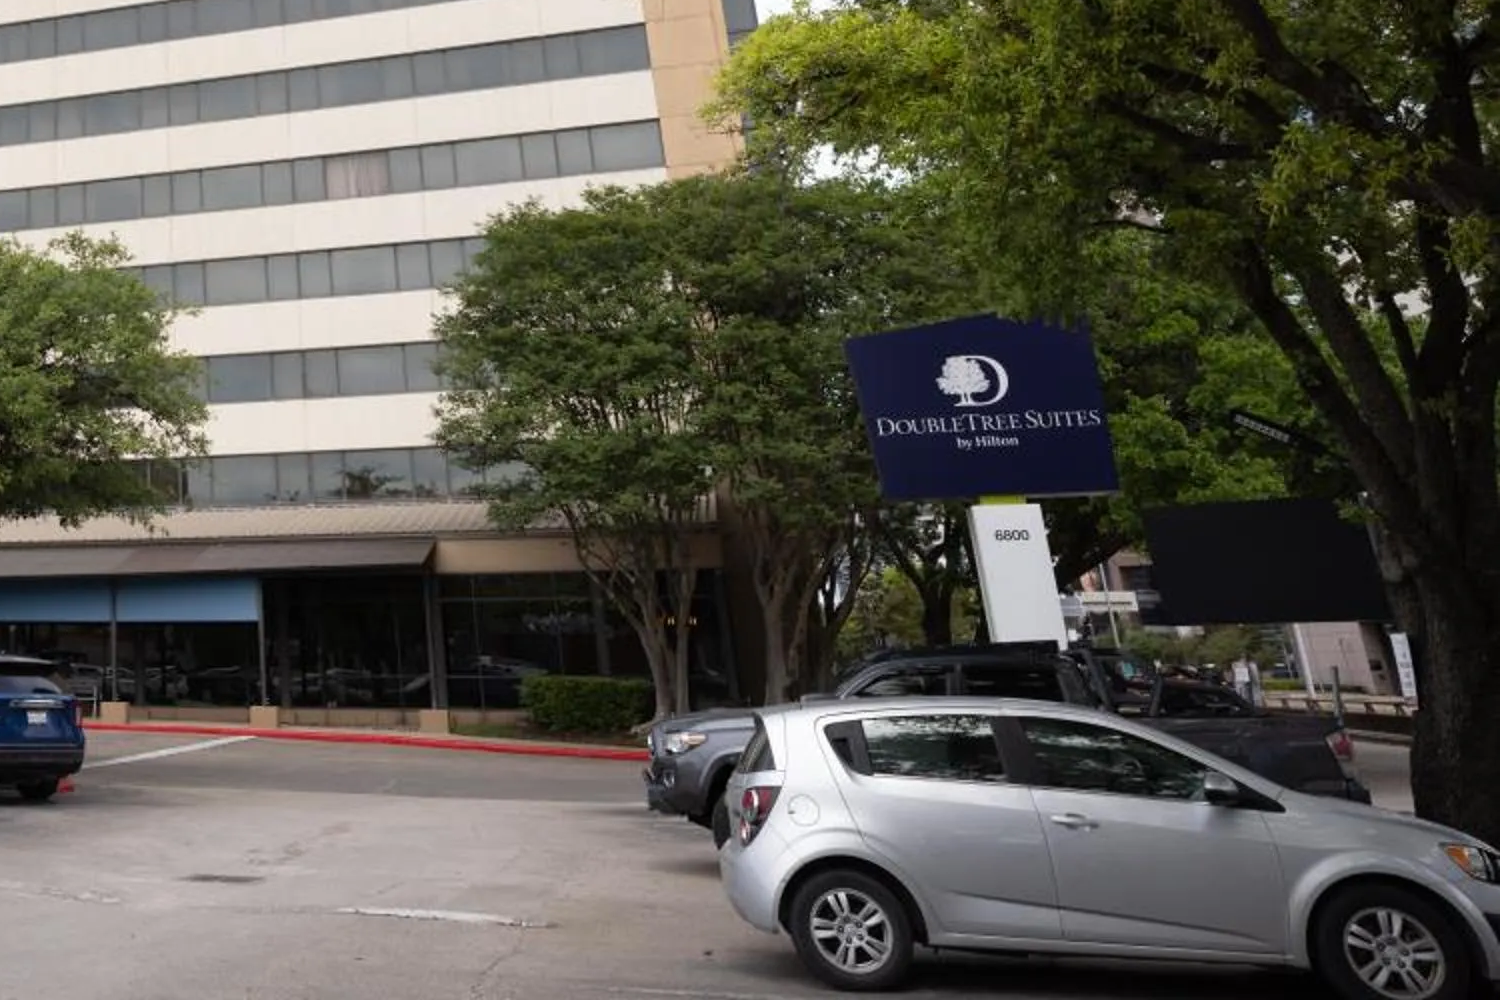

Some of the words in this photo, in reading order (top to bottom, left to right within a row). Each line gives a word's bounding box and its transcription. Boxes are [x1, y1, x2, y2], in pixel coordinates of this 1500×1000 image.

[1025, 408, 1101, 430] SUITES
[957, 436, 972, 449] by
[975, 435, 1019, 448] Hilton
